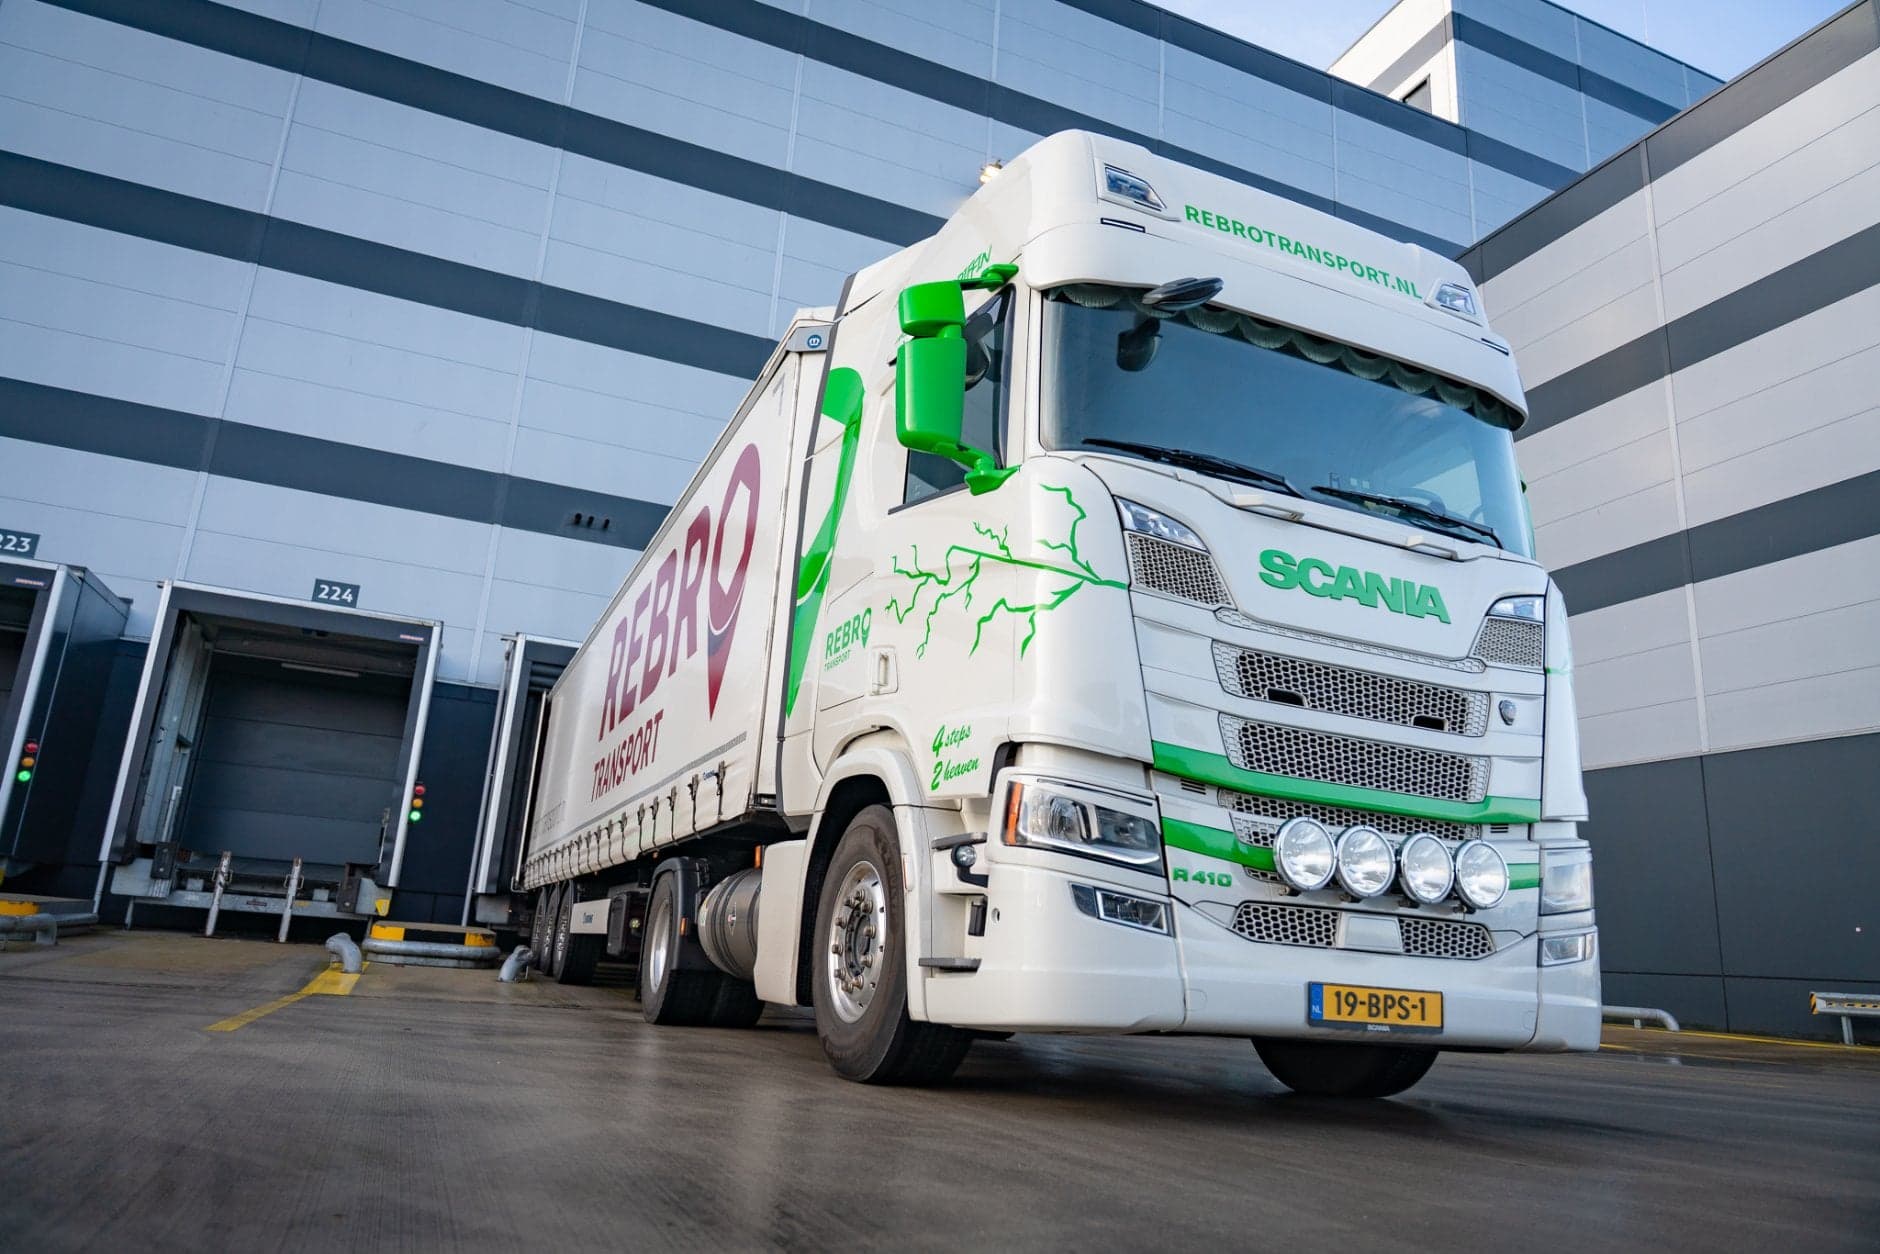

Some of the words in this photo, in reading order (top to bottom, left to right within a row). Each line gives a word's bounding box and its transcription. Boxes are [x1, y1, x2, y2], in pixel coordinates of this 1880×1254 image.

[1185, 205, 1423, 300] REBROTRANSPORT.NL
[0, 534, 31, 552] 23
[318, 585, 353, 603] 224
[598, 442, 761, 742] REBRO
[1258, 549, 1451, 624] SCANIA
[825, 607, 872, 659] REBRO
[591, 709, 664, 802] TRANSPORT
[932, 724, 945, 757] 4
[945, 725, 971, 748] steps
[931, 760, 943, 791] 2
[943, 758, 979, 781] heaven
[1173, 867, 1188, 882] R
[1192, 870, 1232, 887] 410
[1311, 1005, 1322, 1014] NL
[1335, 990, 1426, 1021] 19-BPS-1
